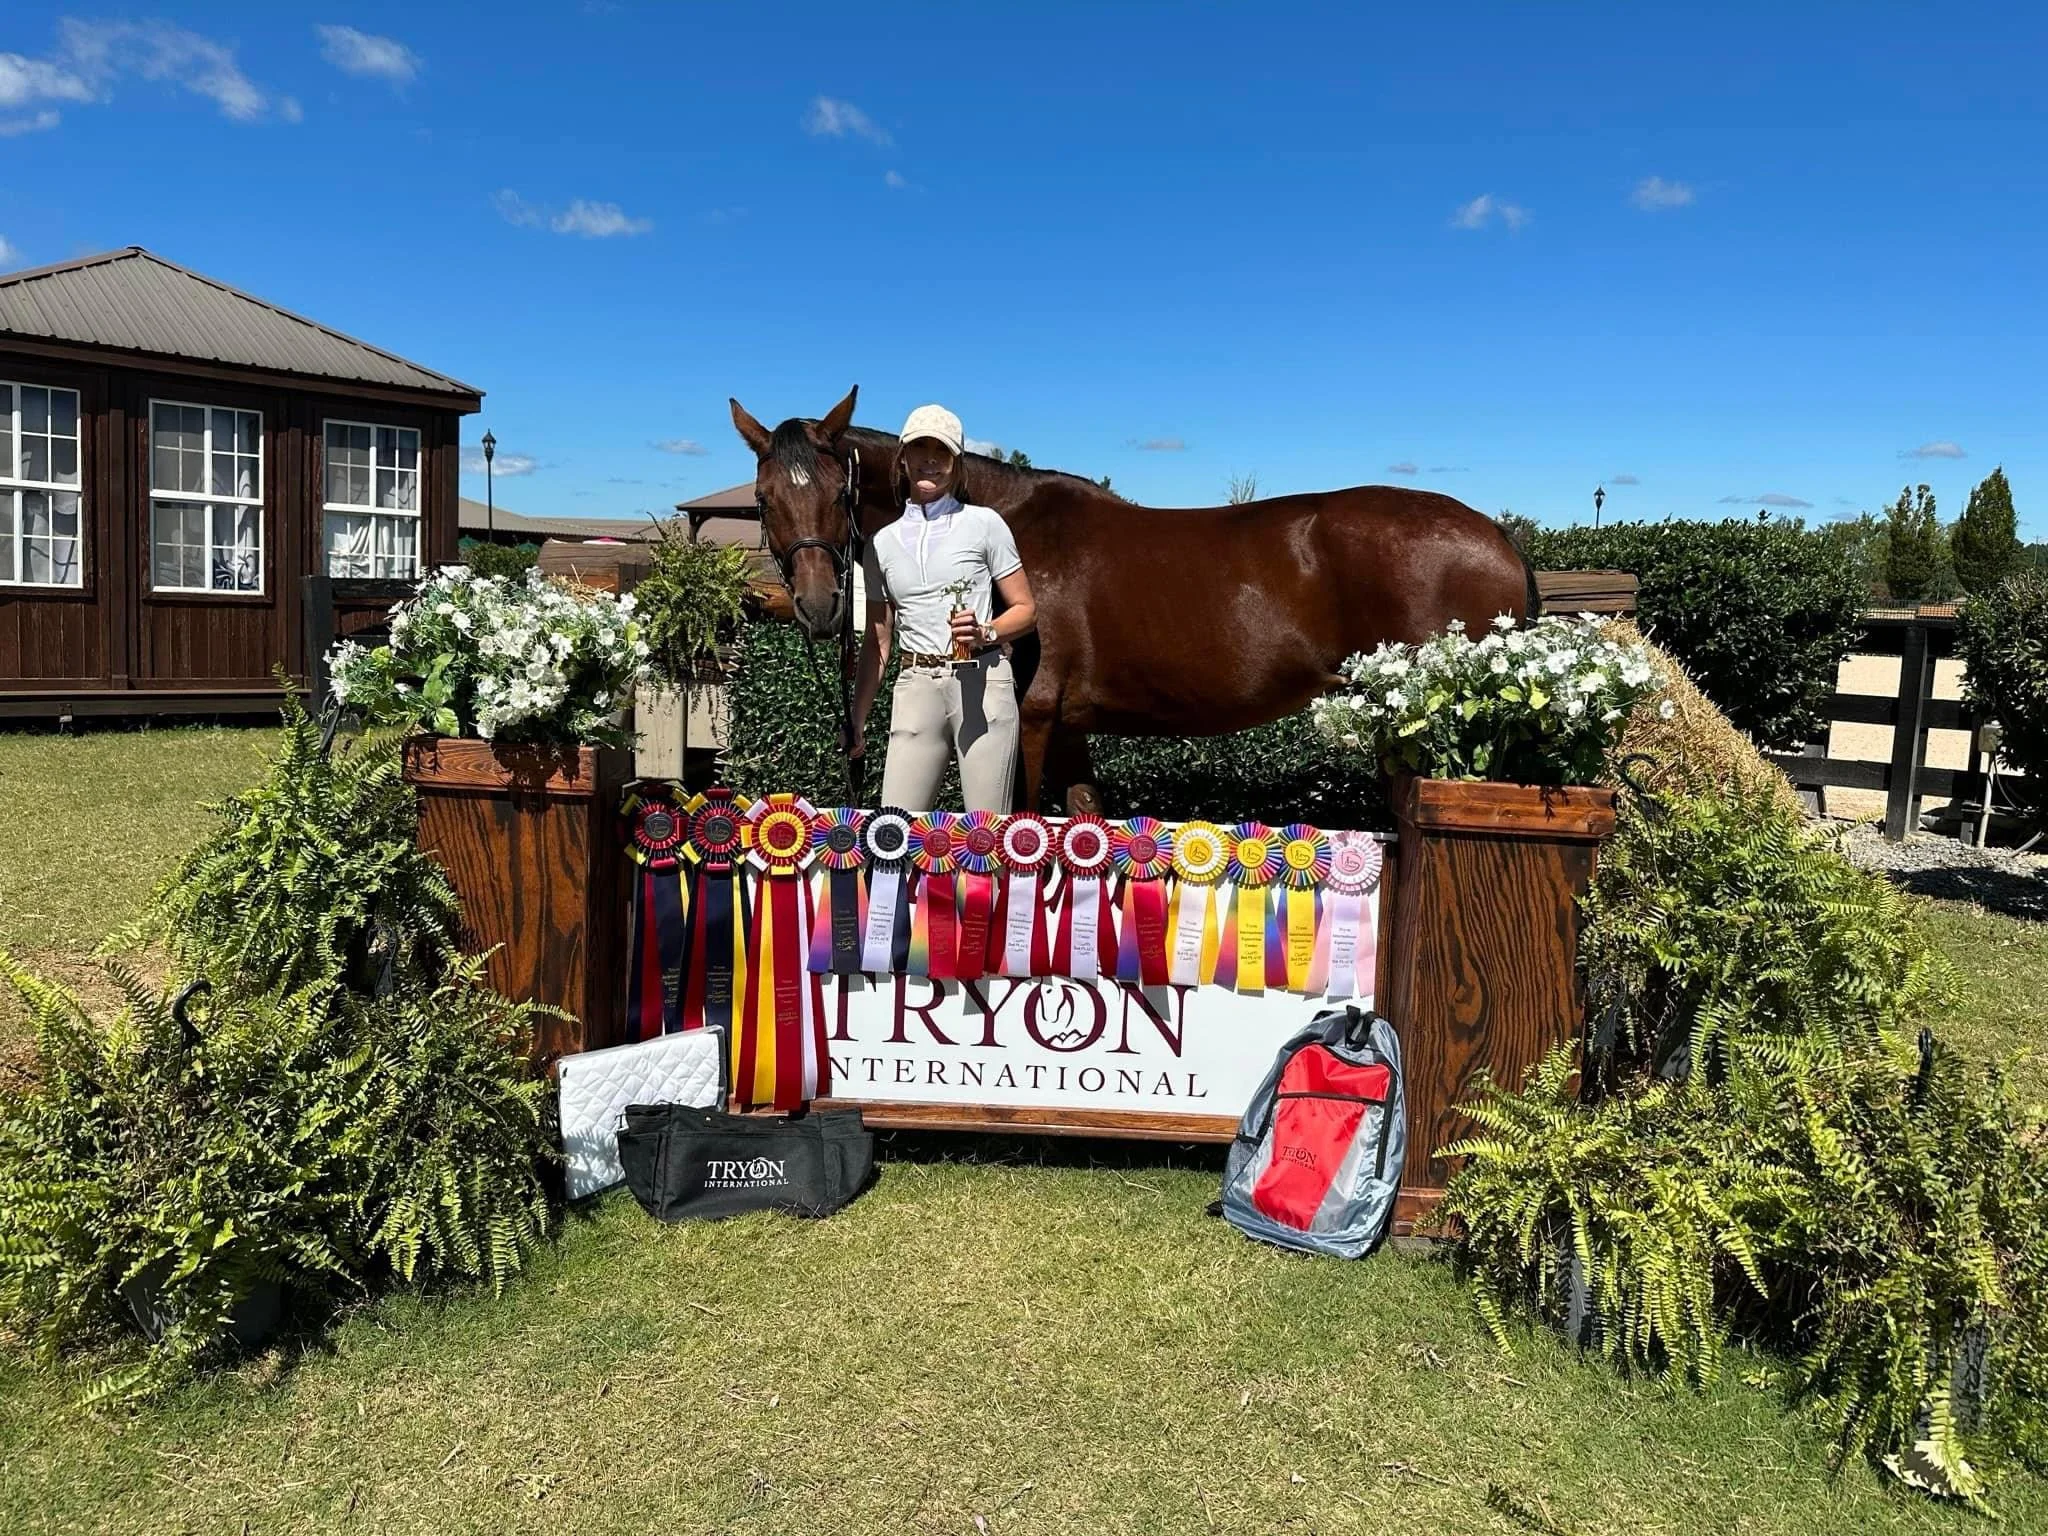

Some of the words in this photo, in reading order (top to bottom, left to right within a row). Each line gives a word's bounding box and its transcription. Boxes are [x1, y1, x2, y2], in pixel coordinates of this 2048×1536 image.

[829, 1056, 1209, 1098] NTERNATIONAL
[707, 1157, 785, 1179] TRYON
[704, 1178, 789, 1188] INTERNATIONAL
